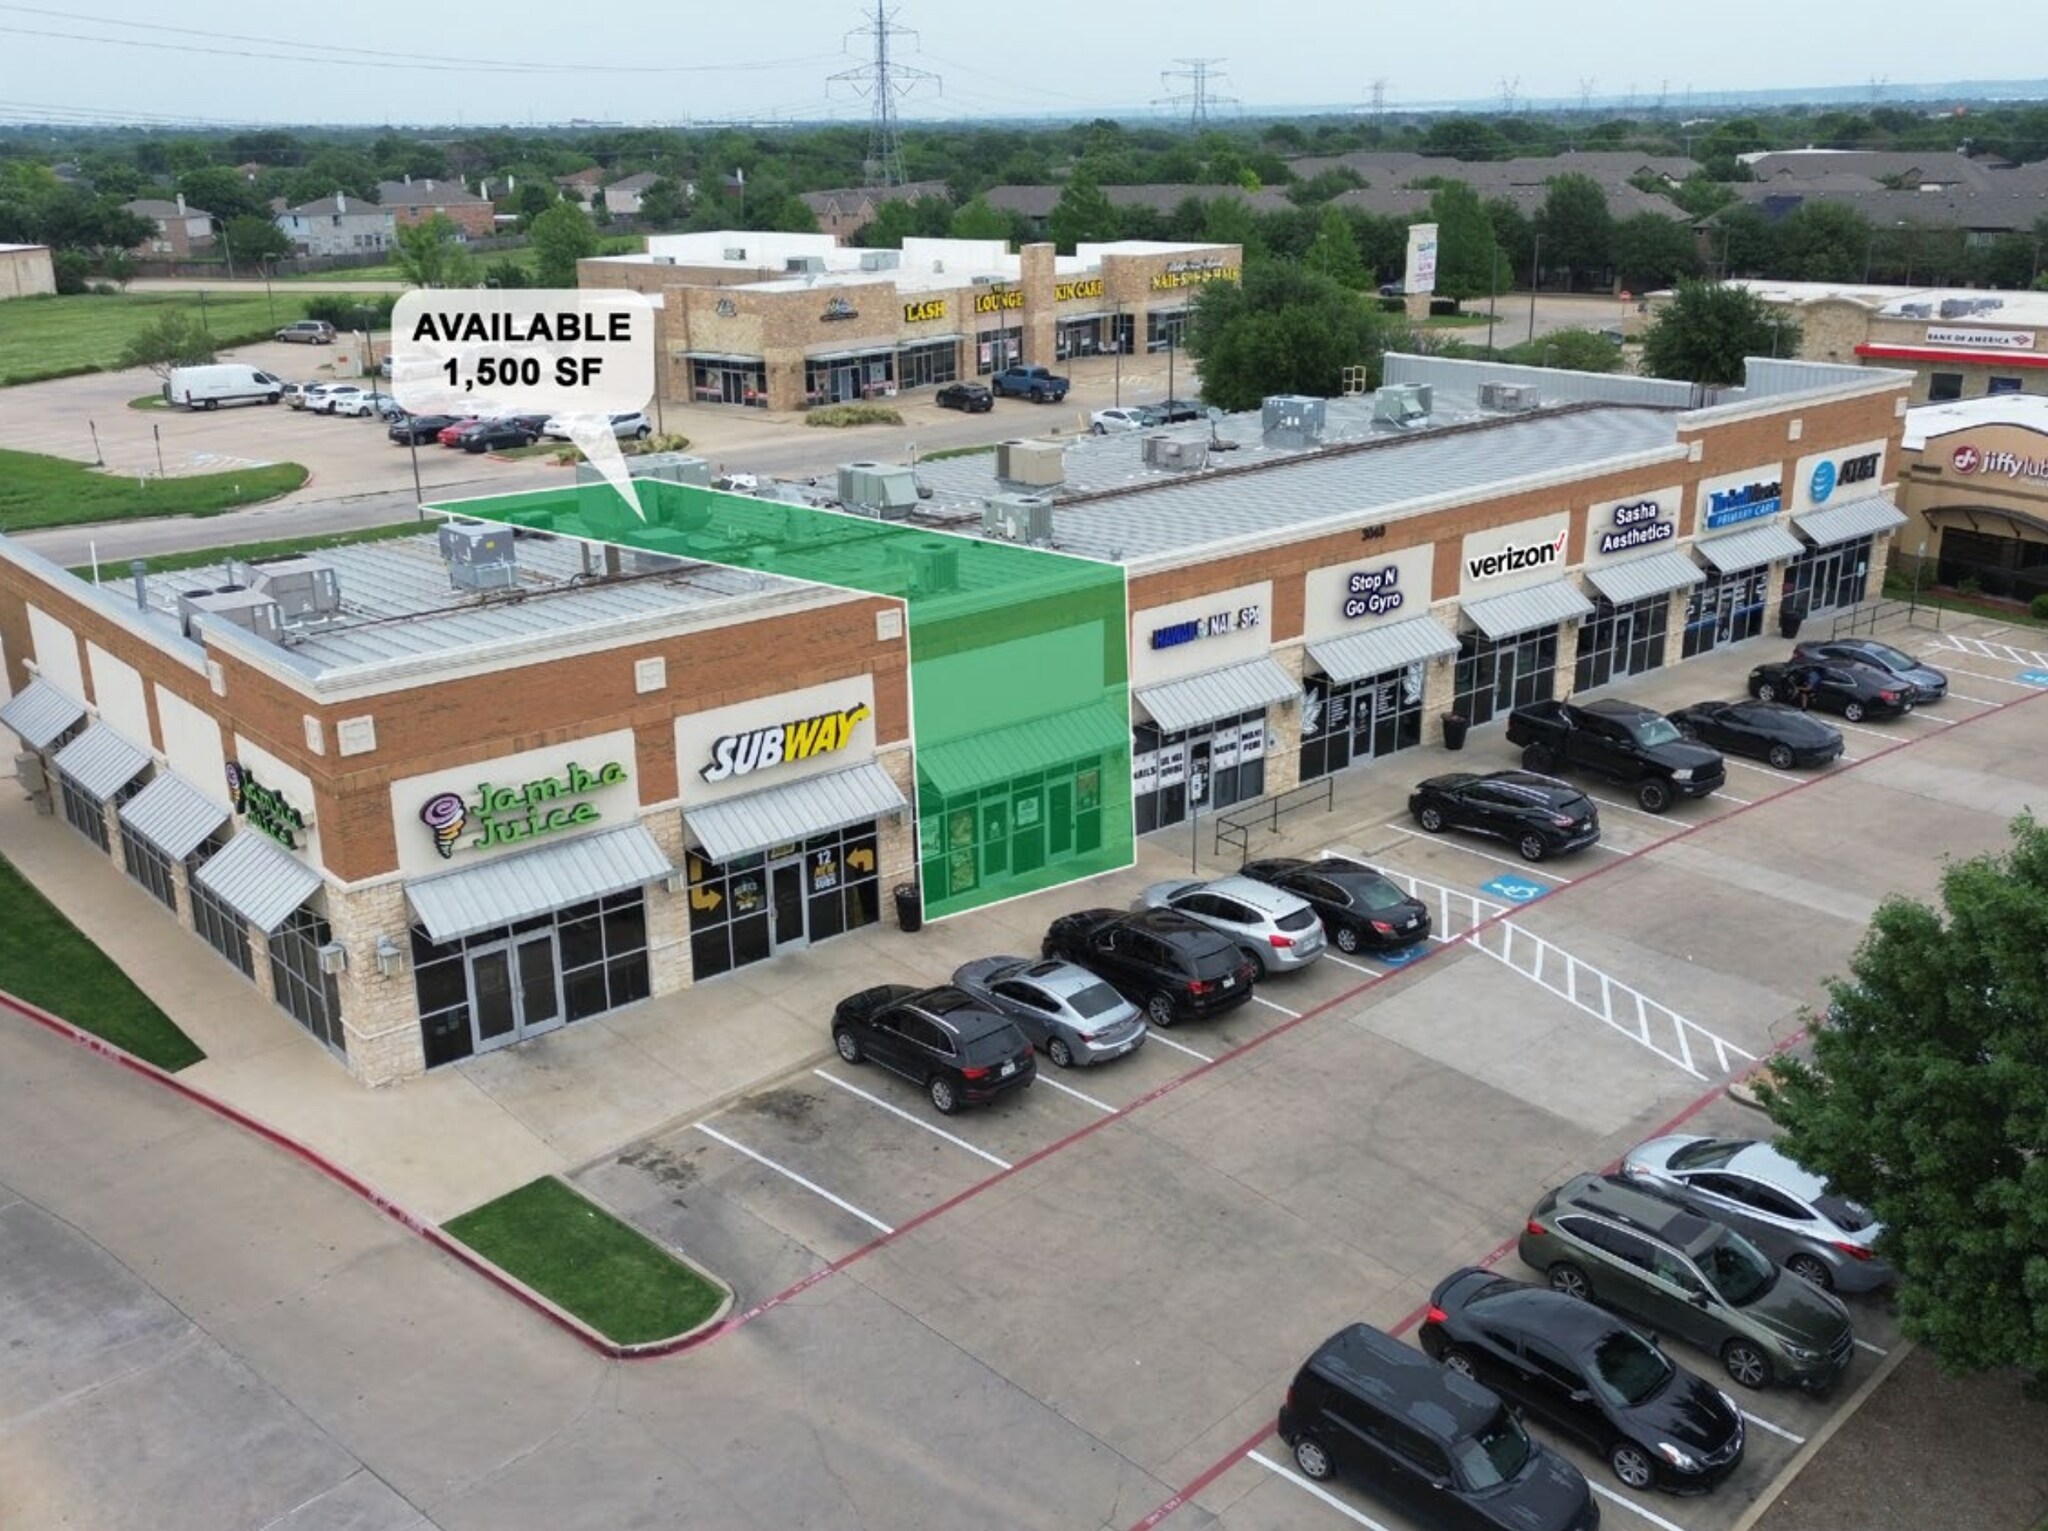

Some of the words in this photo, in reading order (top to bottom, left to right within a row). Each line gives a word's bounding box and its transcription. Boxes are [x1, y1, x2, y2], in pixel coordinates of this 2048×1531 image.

[1054, 283, 1073, 302] KIN
[903, 300, 945, 322] LASH
[1927, 333, 1952, 341] BANK
[1967, 335, 2009, 344] AMERICA
[1837, 453, 1881, 486] AT&T
[1981, 451, 2022, 478] jiffy
[1615, 504, 1656, 525] Sasha
[1717, 508, 1752, 525] PRIMARY
[1754, 502, 1775, 516] CARE
[1602, 523, 1671, 552] Aesthetics
[1470, 543, 1554, 578] verizon
[1351, 573, 1381, 595] Stop
[1385, 568, 1397, 585] N
[1346, 600, 1365, 616] Go
[1368, 593, 1401, 614] Gyro
[1239, 606, 1259, 629] SPA
[700, 702, 871, 783] SUBWAY
[470, 761, 627, 817] Jamba
[473, 801, 601, 851] Juice
[817, 850, 831, 864] 12
